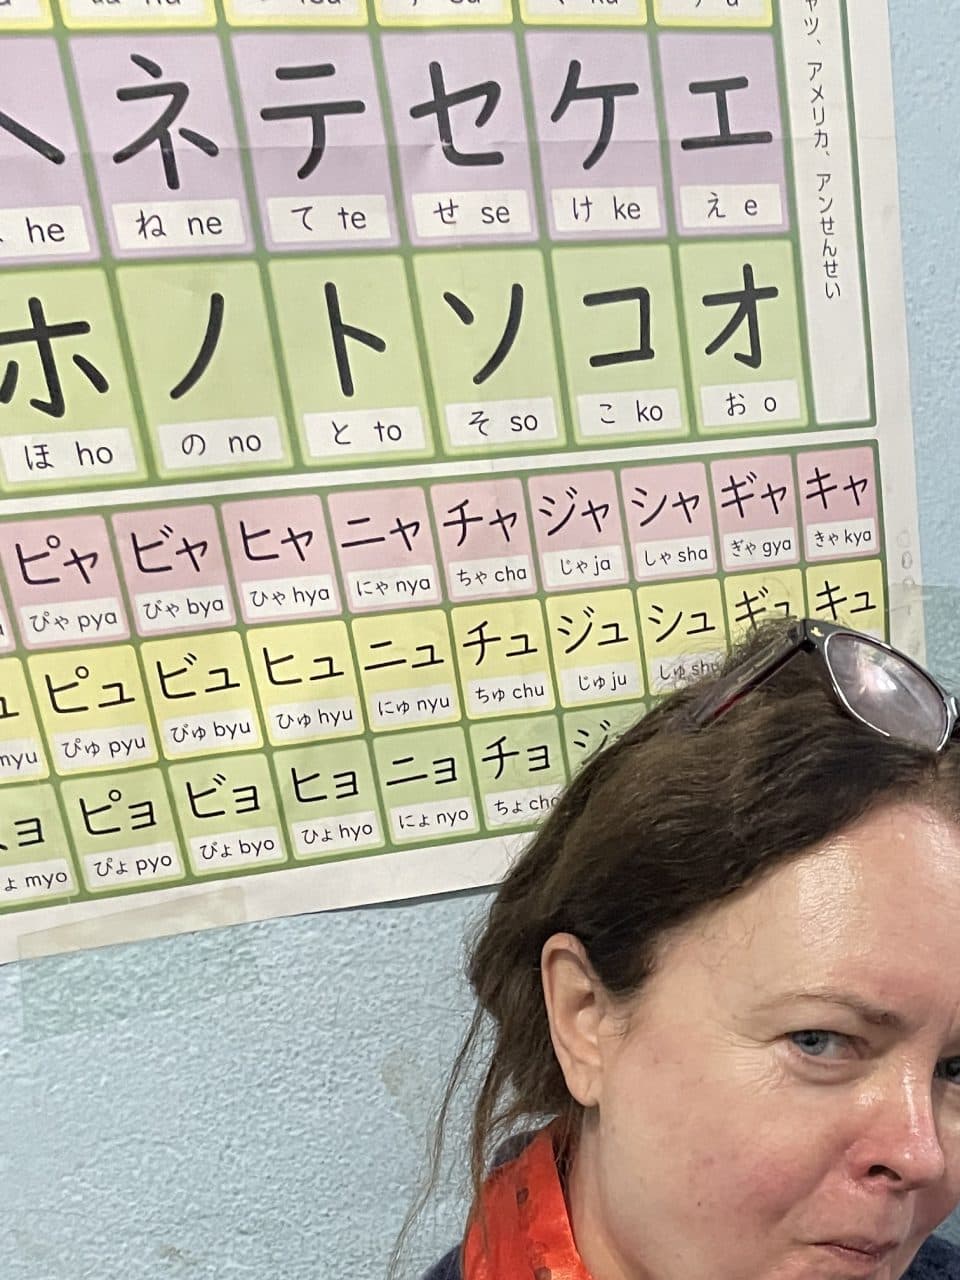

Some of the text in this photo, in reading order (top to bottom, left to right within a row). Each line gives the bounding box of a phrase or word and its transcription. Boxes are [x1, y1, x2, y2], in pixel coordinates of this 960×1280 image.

[113, 55, 219, 190] ネ
[260, 64, 365, 179] テ
[410, 61, 504, 166] セ
[551, 60, 639, 170] ケ
[681, 77, 772, 150] エ
[291, 207, 366, 231] て te
[434, 199, 509, 224] せ se
[573, 196, 640, 222] け ke
[708, 192, 757, 218] え e
[26, 217, 64, 243] he
[136, 210, 222, 239] ね ne
[583, 287, 654, 367] コ
[702, 264, 778, 369] オ
[170, 293, 224, 399] ノ
[325, 282, 386, 397] ト
[444, 284, 523, 384] ソ
[0, 297, 108, 417] ホ
[600, 400, 662, 423] こ ko
[726, 393, 776, 416] お o
[332, 421, 401, 444] と to
[469, 411, 537, 436] そ so
[25, 442, 113, 470] ほ ho
[182, 434, 261, 455] の no
[722, 472, 786, 518] ギャ
[806, 468, 867, 509] キャ
[539, 487, 609, 536] ジャ
[632, 488, 699, 526] シャ
[342, 518, 419, 551] ニャ
[443, 499, 517, 546] チャ
[131, 525, 207, 573] ビャ
[240, 521, 312, 561] ヒャ
[732, 540, 791, 557] ぎゃ gya
[815, 529, 871, 547] きゃ kya
[16, 535, 98, 585] ピャ
[561, 560, 610, 576] じゃ ja
[645, 547, 707, 566] しゃ sha
[357, 579, 430, 596] にゃ nya
[457, 566, 526, 586] ちゃ cha
[143, 599, 223, 619] びゃ bya
[250, 587, 329, 607] ひゃ hya
[815, 580, 877, 620] キュ
[30, 611, 117, 632] ぴゃ pya
[558, 607, 628, 653] ジュ
[648, 605, 715, 642] シュ
[365, 641, 444, 670] ニュ
[463, 621, 537, 665] チュ
[157, 653, 240, 699] ビュ
[263, 648, 344, 685] ヒュ
[45, 666, 135, 713] ピュ
[476, 684, 544, 703] ちゅ chu
[579, 675, 626, 691] じゅ ju
[276, 709, 352, 729] ひゅ hyu
[379, 698, 449, 716] にゅ nyu
[171, 722, 250, 742] びゅ byu
[573, 720, 611, 766] ジ
[62, 738, 145, 758] ぴゅ pyu
[482, 736, 550, 779] チョ
[292, 768, 358, 802] ヒョ
[387, 757, 457, 785] ニョ
[186, 774, 260, 818] ビョ
[495, 800, 522, 815] ちょ
[80, 790, 156, 835] ピョ
[399, 810, 468, 829] にょ nyo
[0, 818, 44, 850] ョ
[302, 825, 372, 844] ひょ hyo
[200, 840, 274, 859] びょ byo
[26, 872, 67, 889] myo
[94, 856, 171, 876] ぴょ pyo
